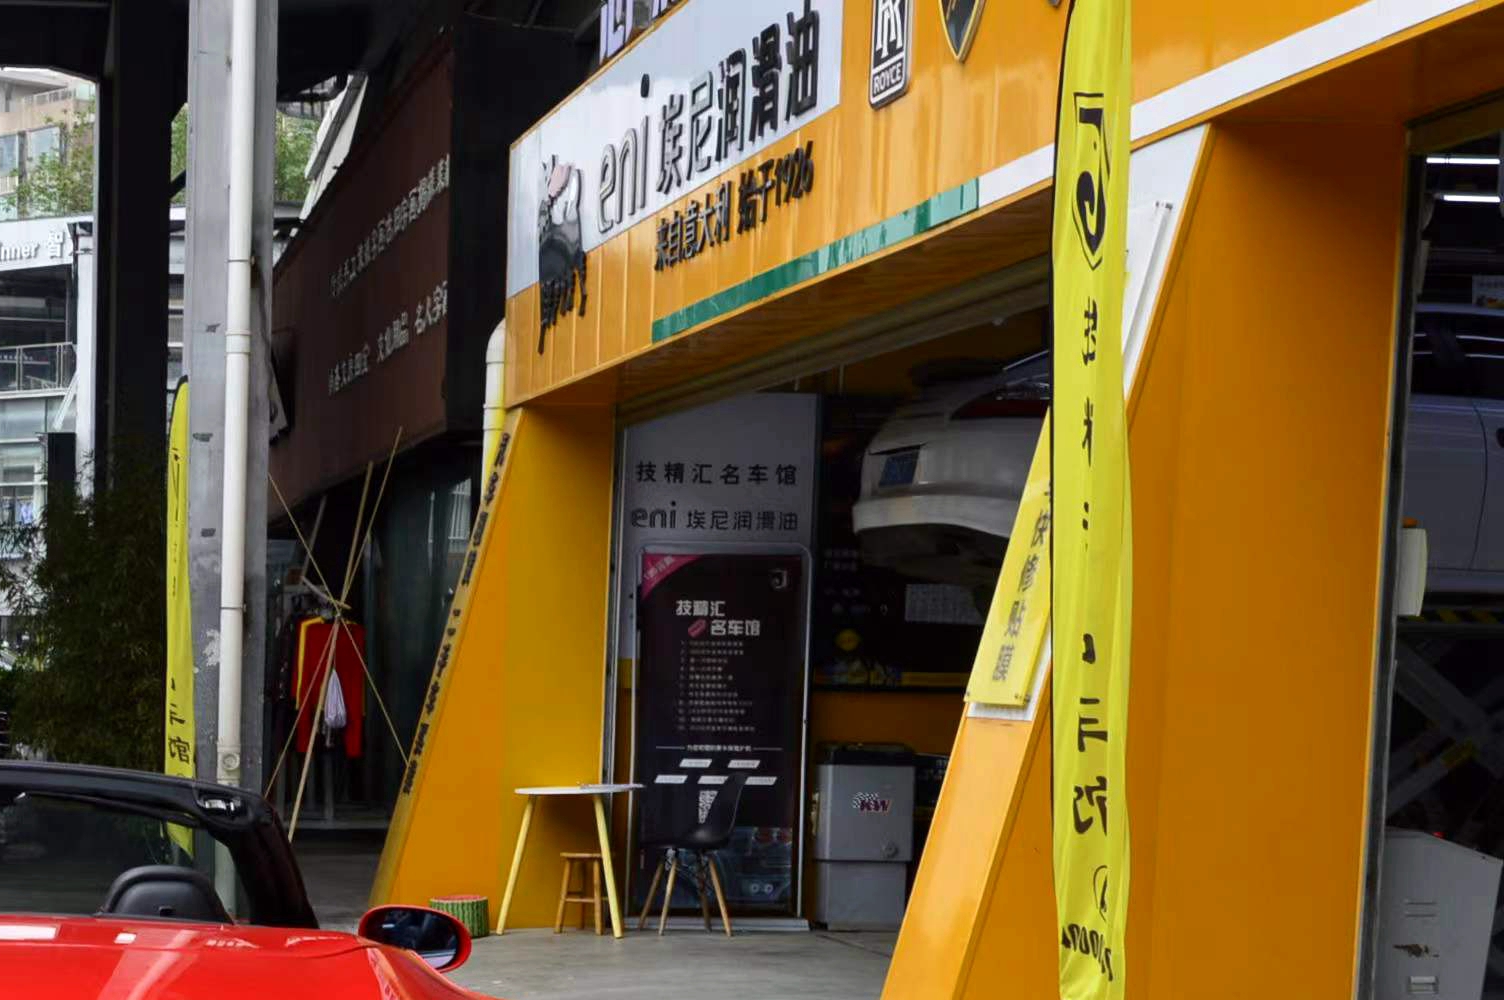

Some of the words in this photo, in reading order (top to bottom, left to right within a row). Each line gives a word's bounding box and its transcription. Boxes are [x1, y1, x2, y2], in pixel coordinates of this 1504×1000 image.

[872, 61, 903, 95] ROYCE
[597, 73, 651, 234] eni
[656, 0, 820, 195] 埃尼润滑油
[654, 180, 732, 271] 来自意大利
[736, 140, 814, 235] 始于1926
[636, 461, 798, 485] 技精汇名车馆
[631, 500, 677, 529] eni
[686, 509, 799, 531] 埃尼润滑油
[676, 600, 725, 616] 技精汇
[710, 620, 760, 636] 名车馆
